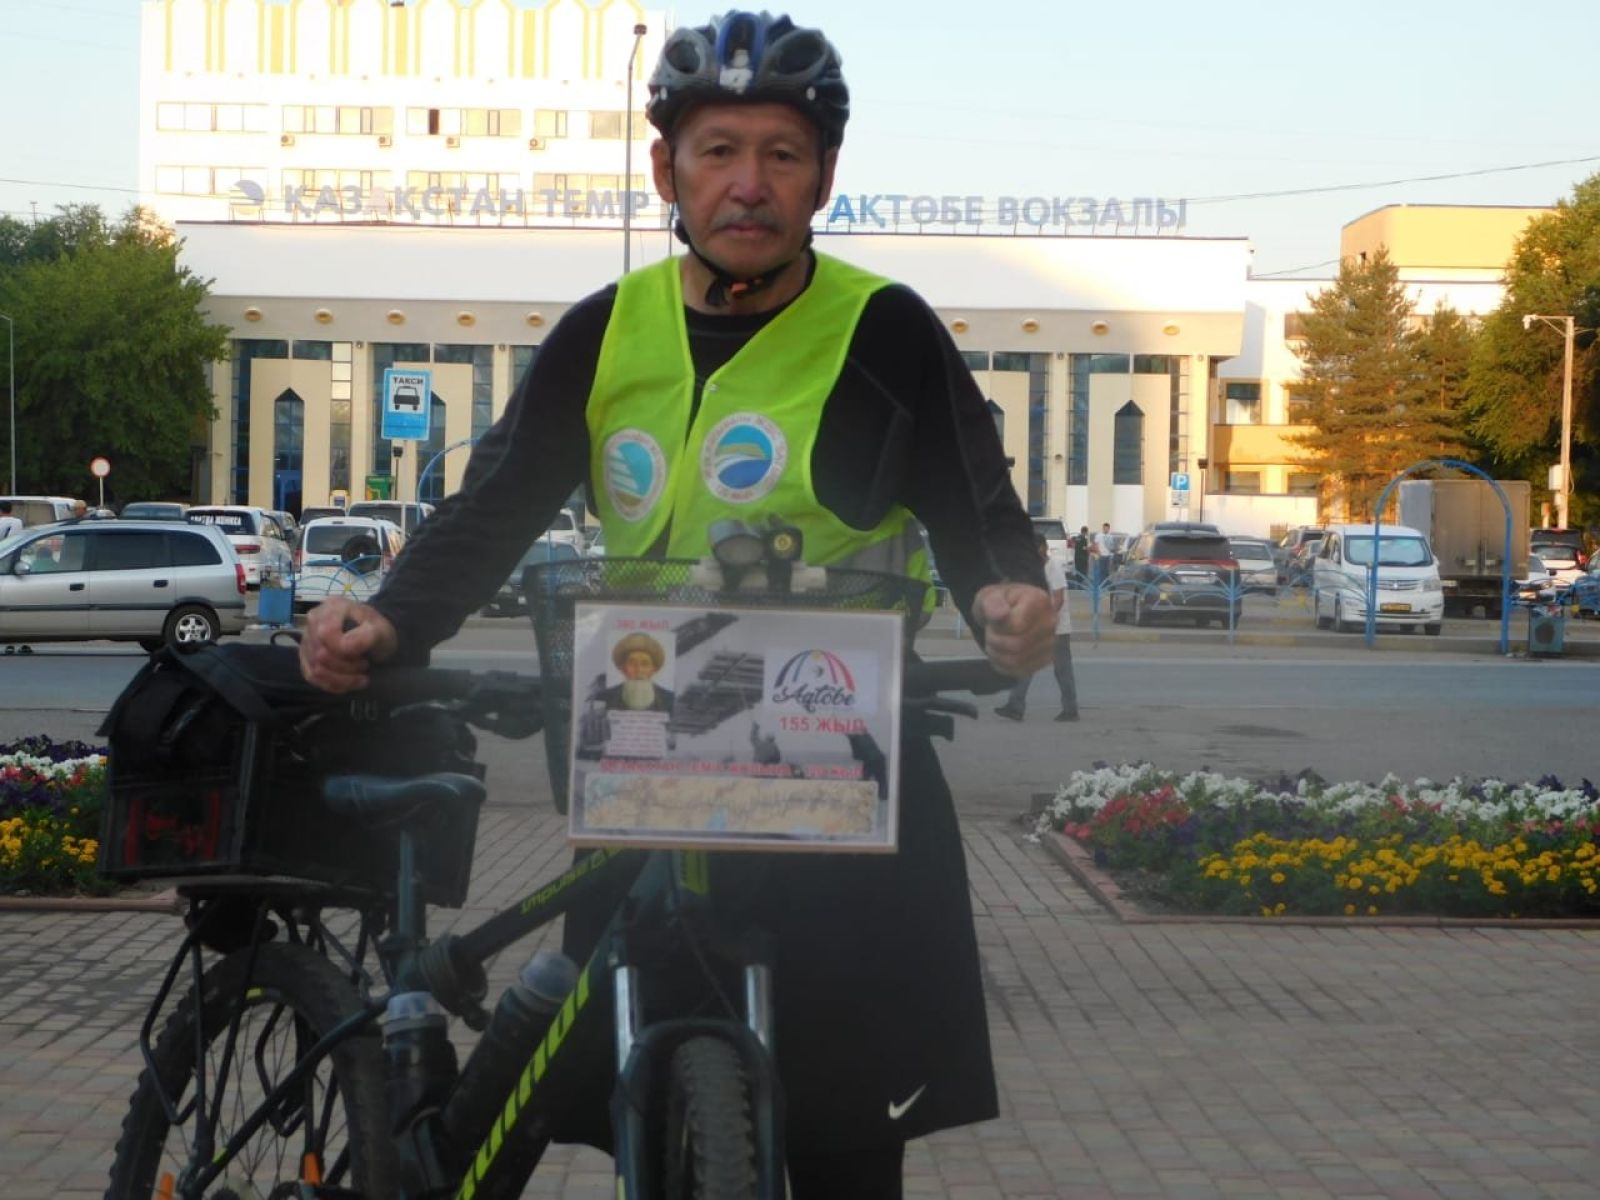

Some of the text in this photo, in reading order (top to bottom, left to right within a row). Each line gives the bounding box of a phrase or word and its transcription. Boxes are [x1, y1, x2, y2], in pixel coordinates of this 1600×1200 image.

[828, 194, 1188, 228] АҚТӨБЕ ВОКЗАЛЫ
[779, 716, 810, 731] 155
